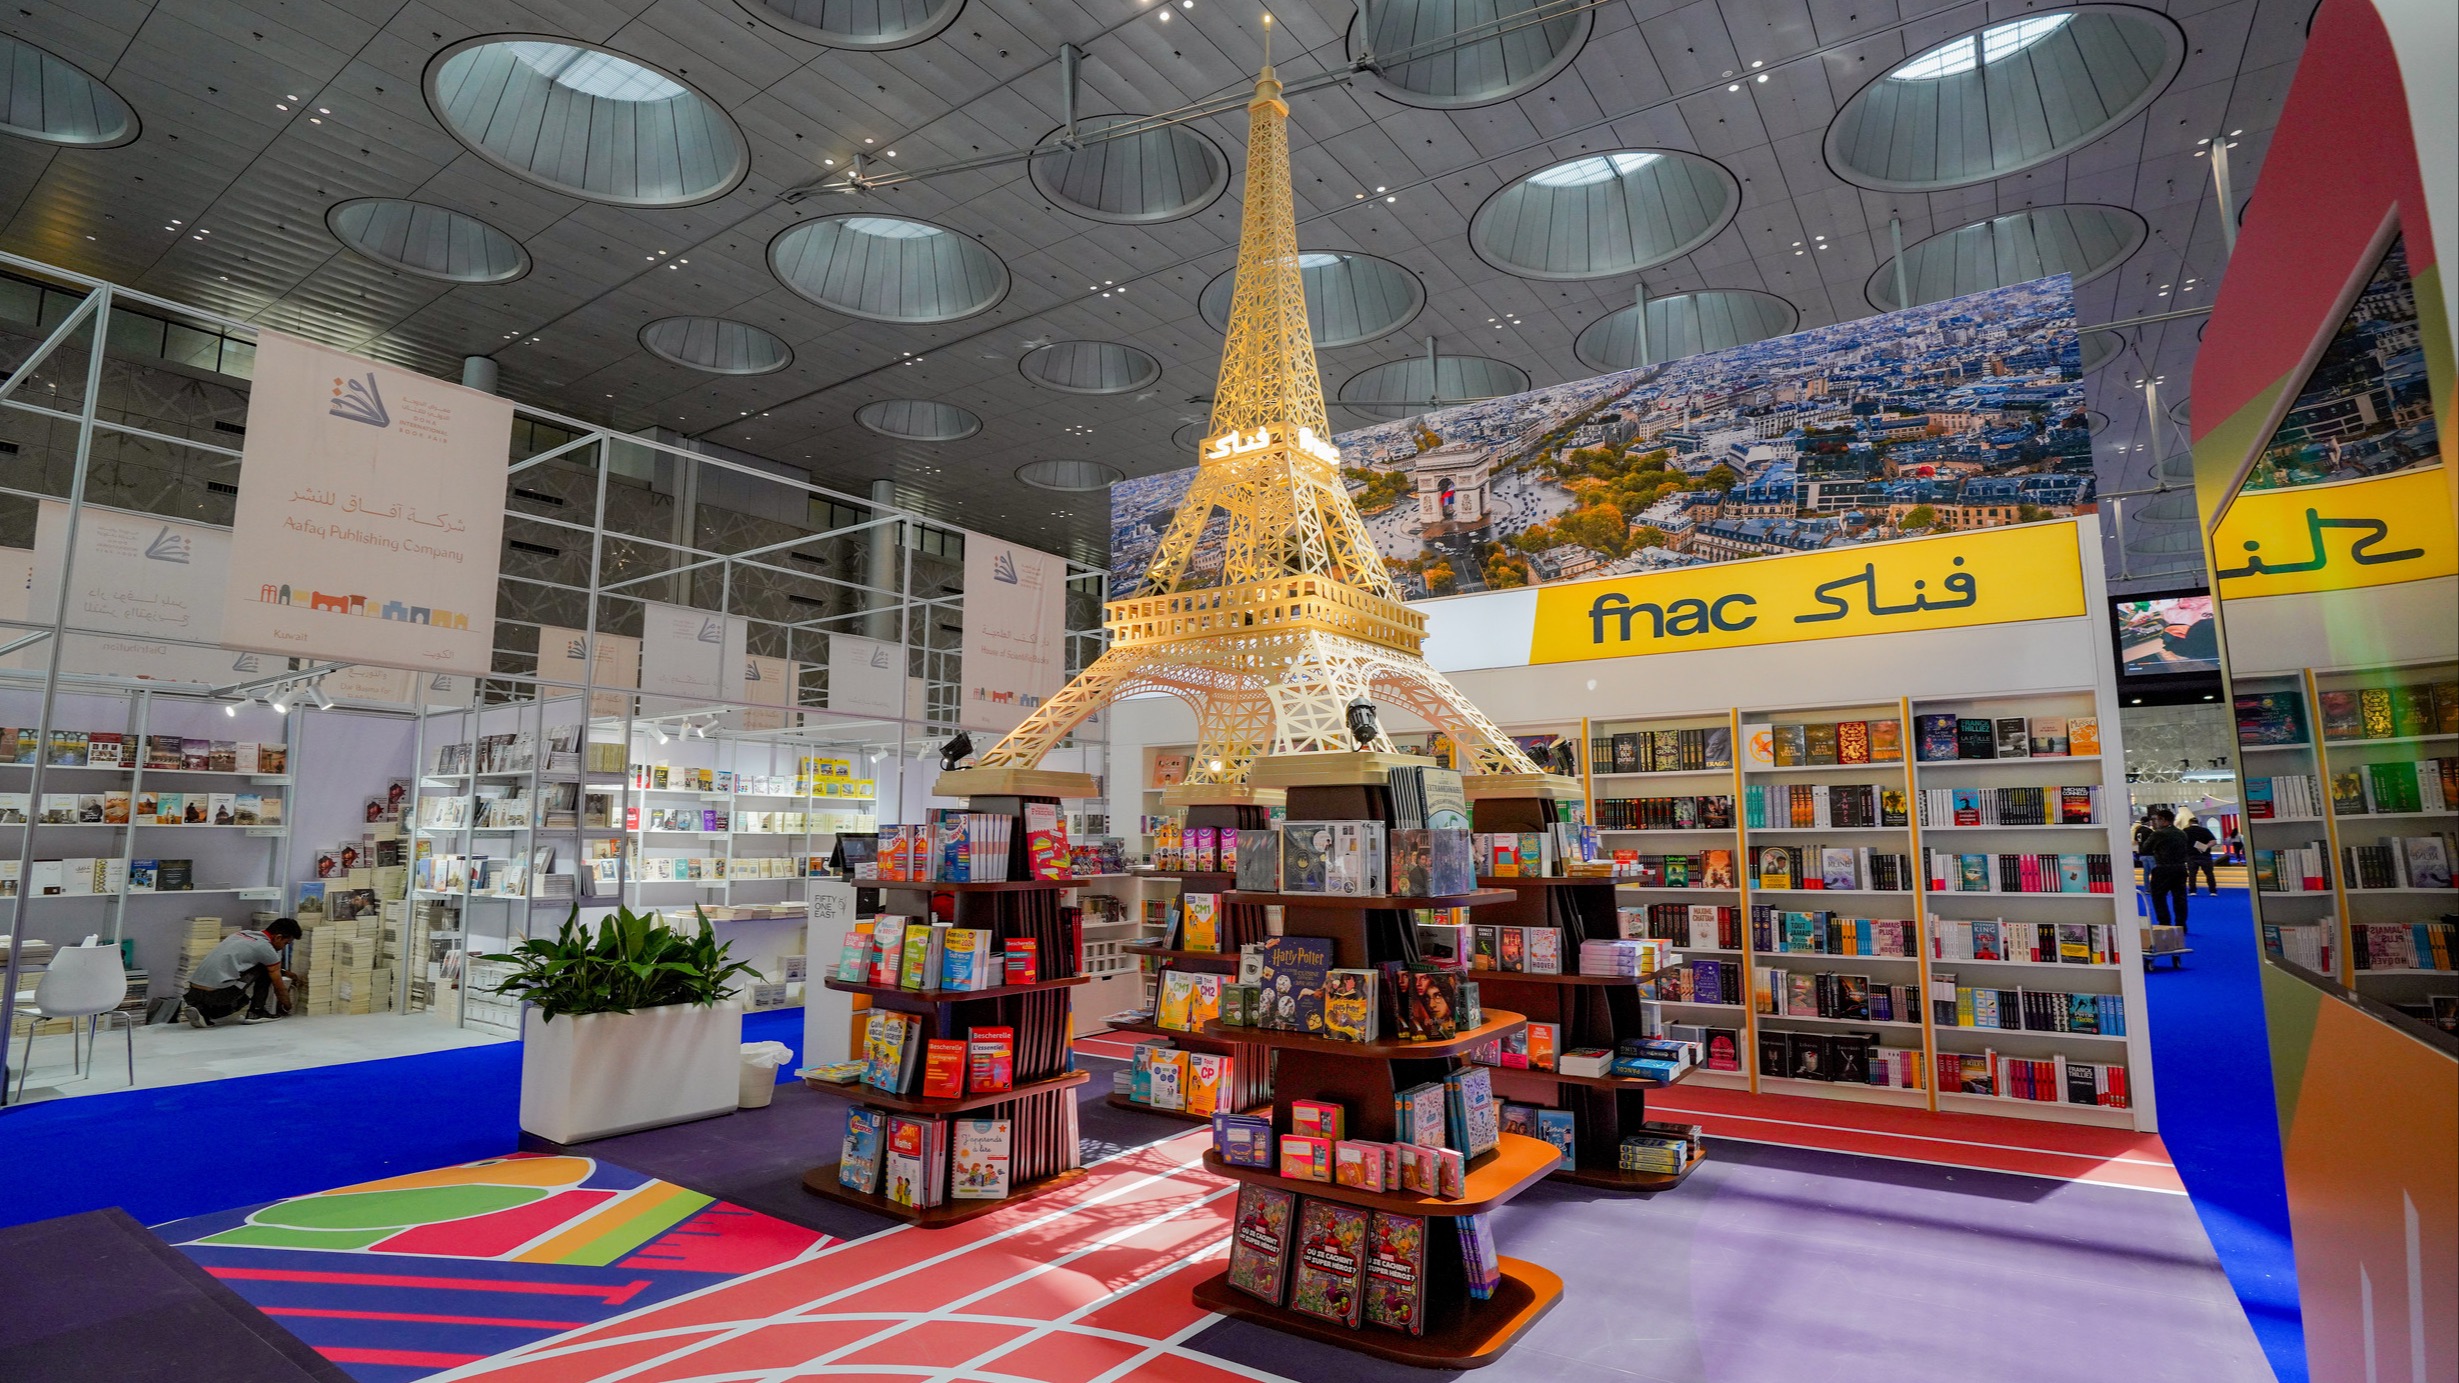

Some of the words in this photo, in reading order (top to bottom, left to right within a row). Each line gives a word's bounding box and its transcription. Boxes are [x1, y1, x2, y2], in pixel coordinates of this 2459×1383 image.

[413, 415, 437, 427] DOHA
[288, 487, 337, 506] للنشر
[341, 495, 404, 519] آفاق
[407, 507, 466, 533] شركة
[282, 515, 326, 540] Aafaq
[329, 524, 401, 553] Publishing
[402, 538, 465, 564] Company
[1793, 556, 1977, 624] فناك
[1588, 592, 1758, 644] fnac
[273, 629, 310, 643] Kuwait
[421, 649, 456, 661] الكويت
[980, 645, 999, 658] House
[1961, 719, 1989, 727] FRANCK
[1961, 725, 1991, 733] THILLIEZ
[1841, 792, 1849, 823] VAMPS
[814, 895, 837, 903] FIFTY
[815, 903, 832, 911] ONE
[1194, 904, 1211, 914] CM1
[814, 911, 836, 919] EAST
[1272, 948, 1297, 967] Harry
[1297, 947, 1325, 967] Potter
[1532, 962, 1555, 970] HOOVER
[1173, 981, 1190, 993] CM1
[1200, 985, 1216, 997] CM2
[929, 1043, 963, 1051] Bescherelle
[1201, 1067, 1215, 1079] CP
[1616, 1065, 1640, 1075] PANCOL
[2068, 1070, 2093, 1079] THILLIEZ
[900, 1125, 917, 1138] CM1
[894, 1138, 913, 1151] Maths
[962, 1133, 1003, 1146] J'apprends
[979, 1145, 992, 1153] lire
[1249, 1229, 1257, 1238] SE
[1256, 1232, 1278, 1245] CACHENT
[1245, 1235, 1261, 1247] SUPER
[1260, 1241, 1281, 1253] HÉROS?
[1306, 1247, 1316, 1256] OÙ
[1316, 1250, 1325, 1259] SE
[1324, 1252, 1355, 1266] CACHENT
[1311, 1257, 1333, 1268] SUPER
[1332, 1261, 1358, 1274] HÉROS?
[1372, 1257, 1382, 1267] SE
[1381, 1260, 1412, 1273] CACHENT
[1367, 1265, 1389, 1276] SUPER
[1388, 1268, 1416, 1282] HÉROS?
